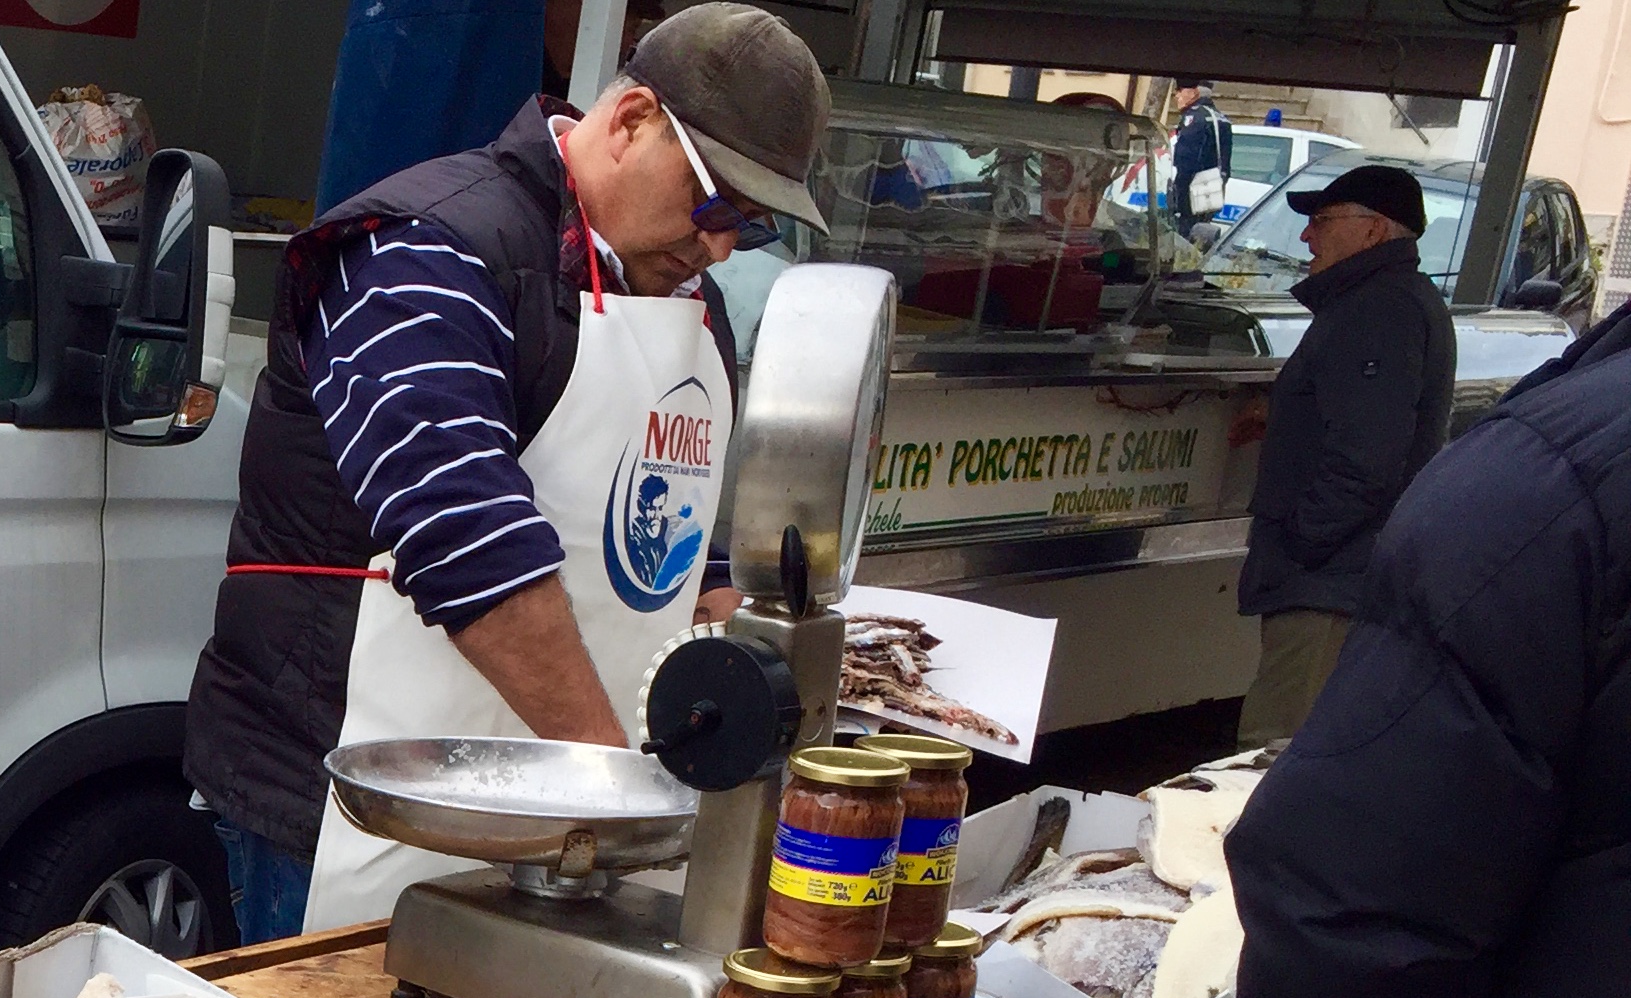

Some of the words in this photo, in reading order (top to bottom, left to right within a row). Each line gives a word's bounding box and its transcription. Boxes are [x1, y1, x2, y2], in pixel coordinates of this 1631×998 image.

[644, 411, 711, 466] NORGE
[948, 432, 1091, 487] PORCHETTA
[1096, 433, 1112, 476] E
[1118, 428, 1199, 473] SALUMI
[1051, 481, 1134, 516] produzione
